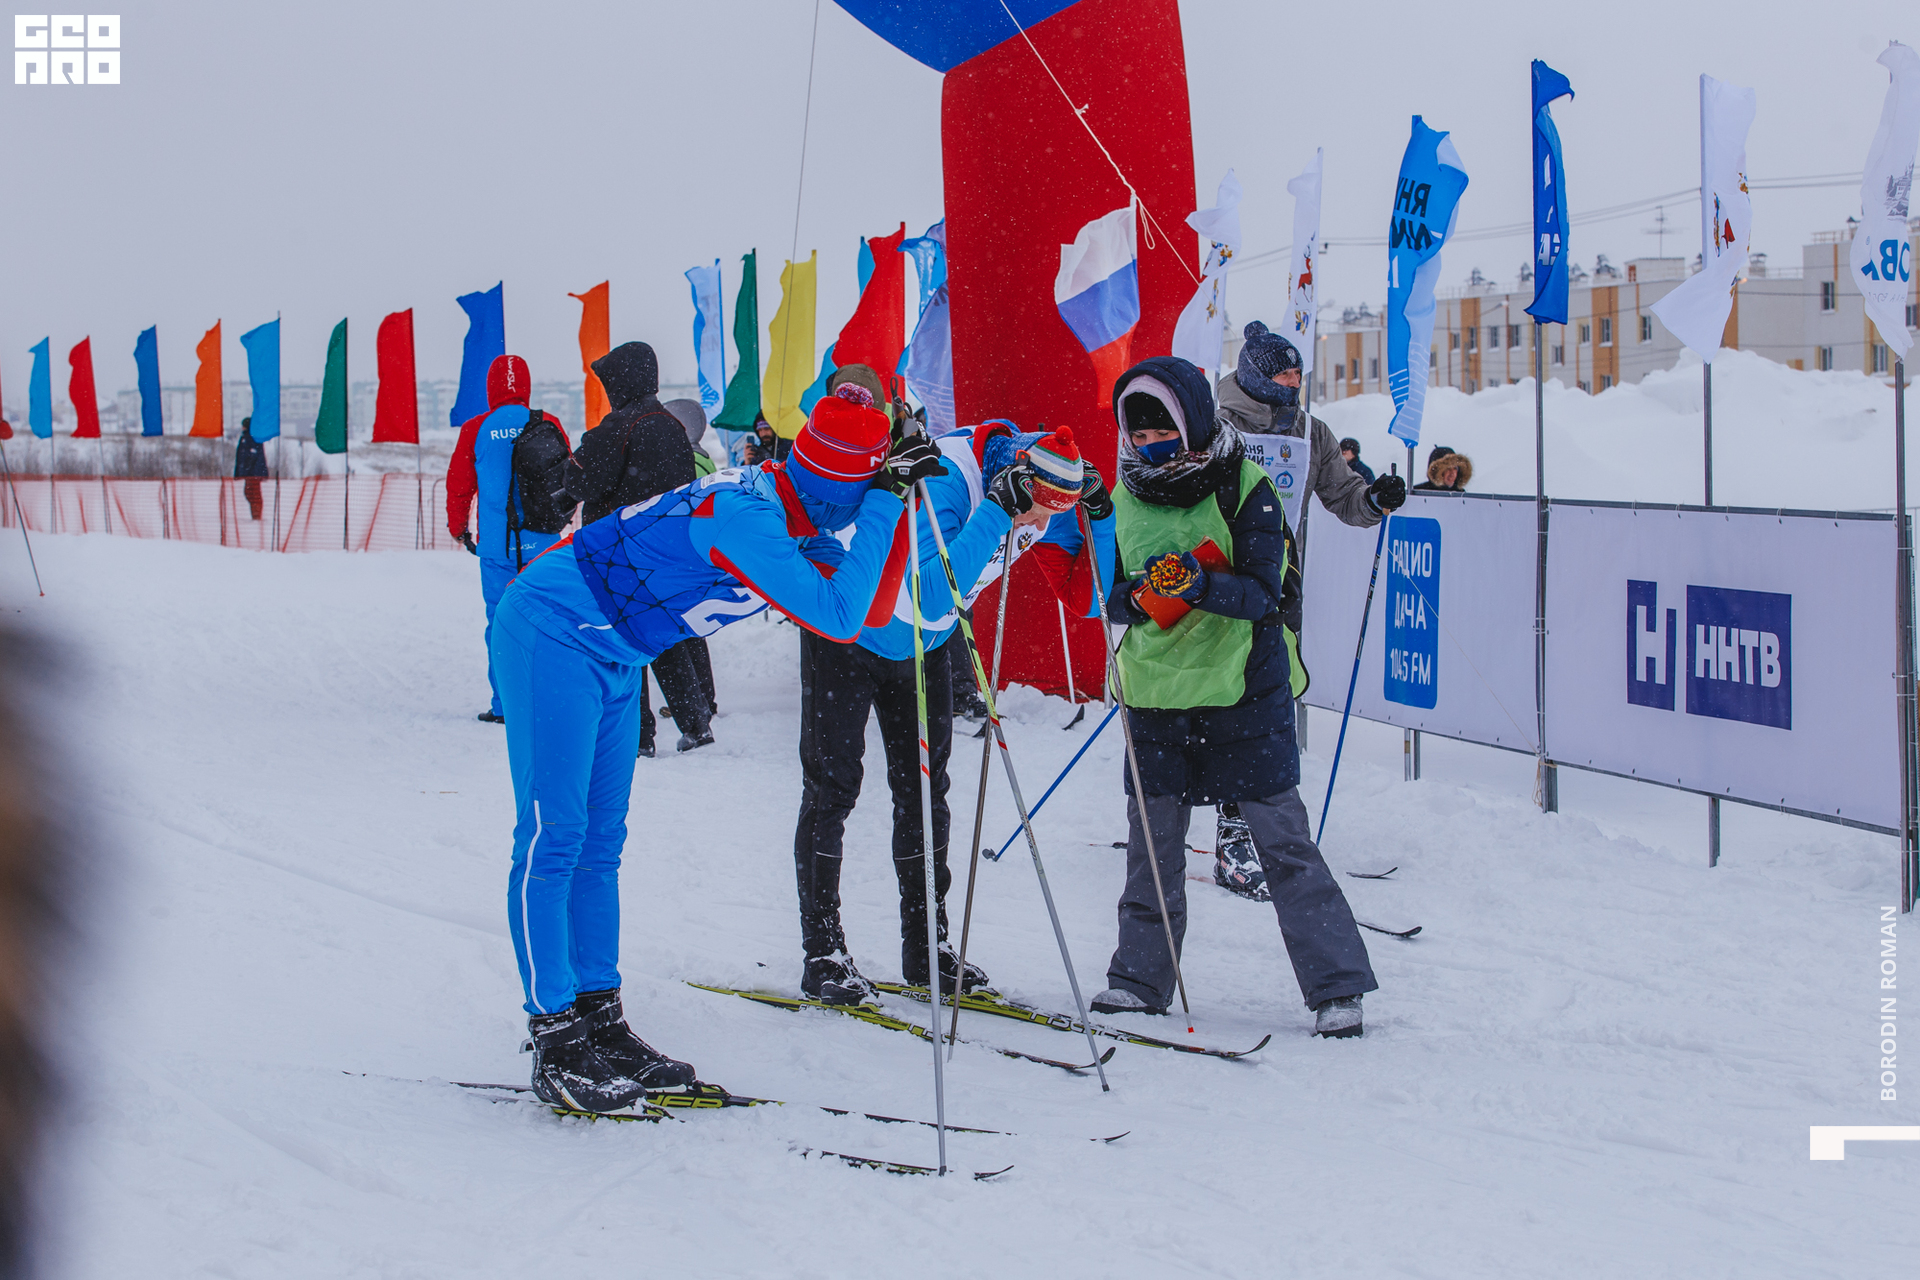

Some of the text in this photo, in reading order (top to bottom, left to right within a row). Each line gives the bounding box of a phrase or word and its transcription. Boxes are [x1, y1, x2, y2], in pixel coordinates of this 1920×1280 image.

[1392, 539, 1433, 578] РАДИО
[1394, 591, 1427, 630] ДАЧА
[1411, 651, 1431, 686] FM
[1695, 624, 1782, 688] ННТВ
